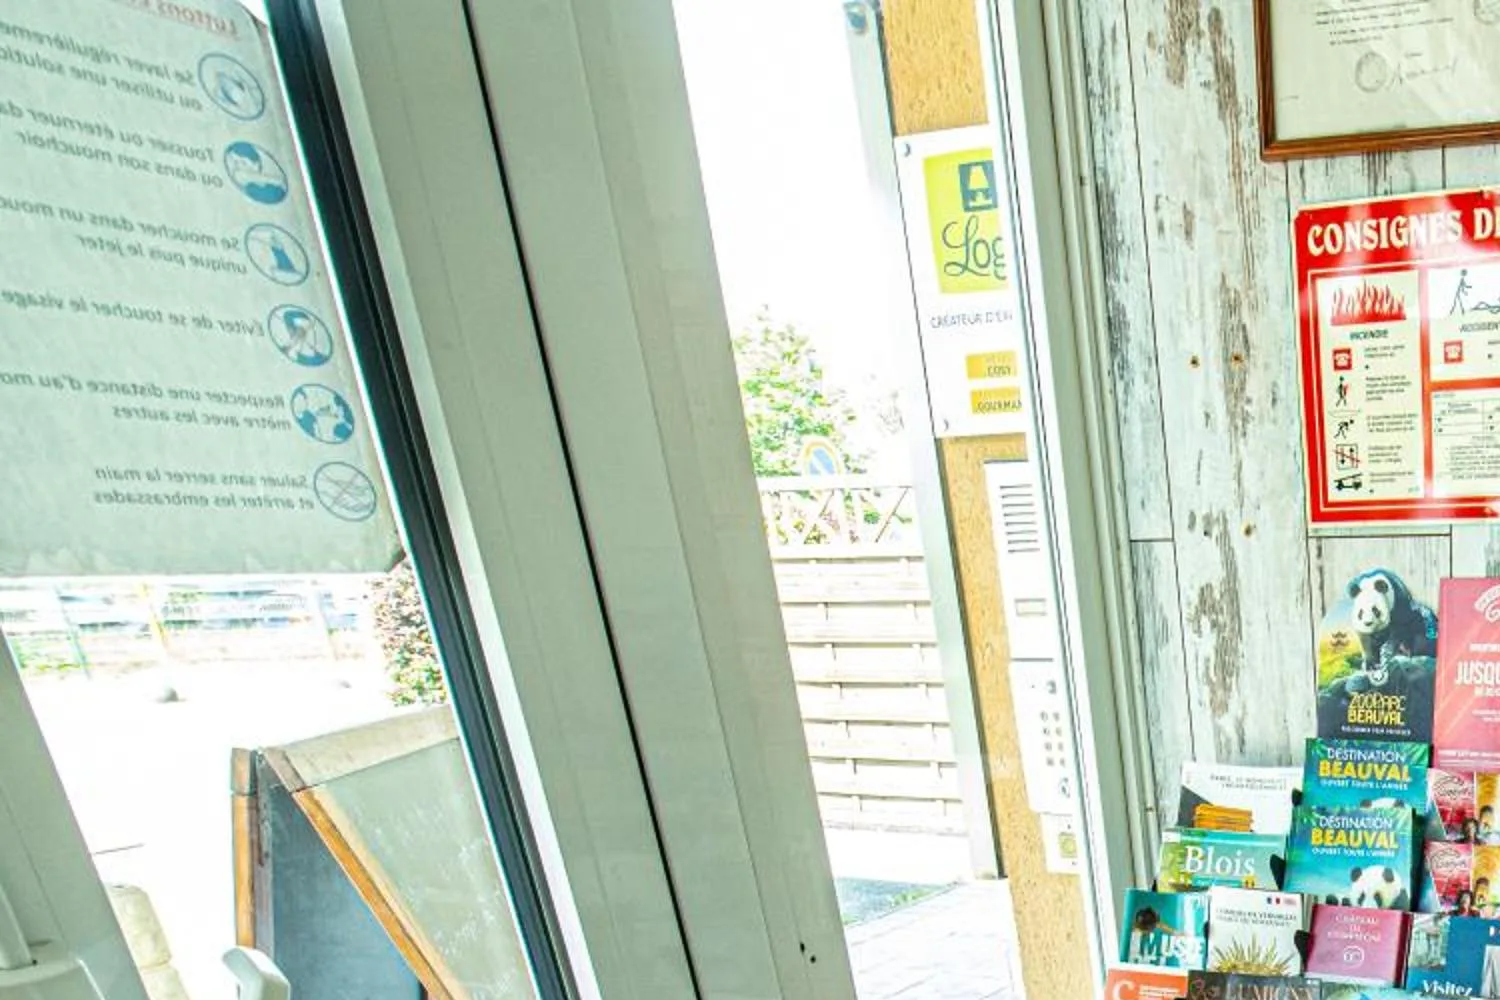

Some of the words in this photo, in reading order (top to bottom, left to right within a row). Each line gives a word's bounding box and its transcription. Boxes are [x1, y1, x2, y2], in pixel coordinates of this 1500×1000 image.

[1307, 209, 1463, 258] CONSIGNES
[1347, 708, 1405, 726] BEAUVAL
[1327, 746, 1406, 763] DESTINATION
[1318, 760, 1411, 782] BEAUVAL
[1319, 815, 1394, 830] DESTINATION
[1311, 828, 1399, 849] BEAUVAL
[1181, 845, 1256, 876] Blois
[1423, 979, 1473, 997] Visitez
